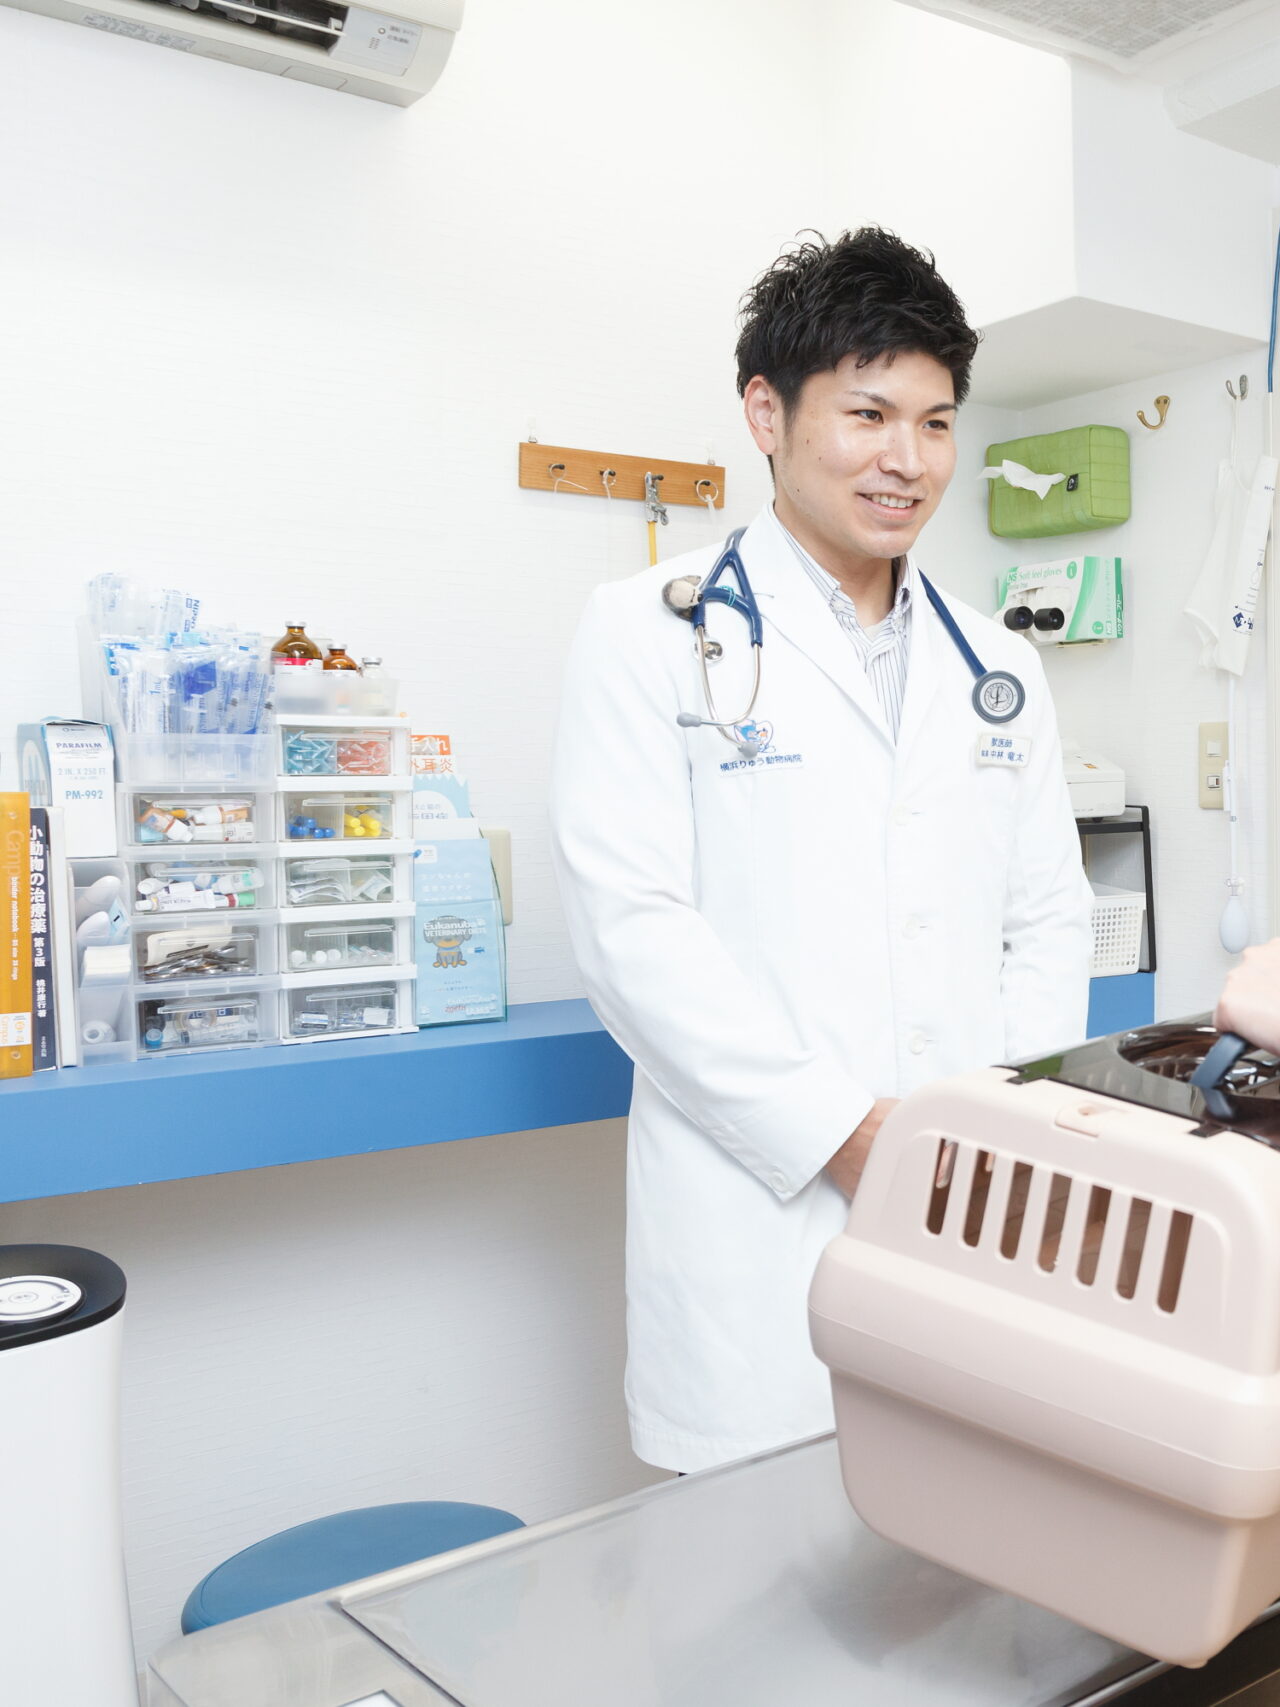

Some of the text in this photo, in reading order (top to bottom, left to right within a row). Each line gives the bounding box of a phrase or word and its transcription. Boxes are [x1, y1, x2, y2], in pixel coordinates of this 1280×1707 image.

[719, 754, 802, 772] 横浜りゅう動物病院
[65, 790, 104, 800] PM-992
[11, 876, 19, 899] binder
[30, 824, 47, 934] 小動物の治療薬
[11, 900, 19, 932] notebook
[423, 920, 477, 931] Eukanuba
[34, 937, 45, 967] 第3版
